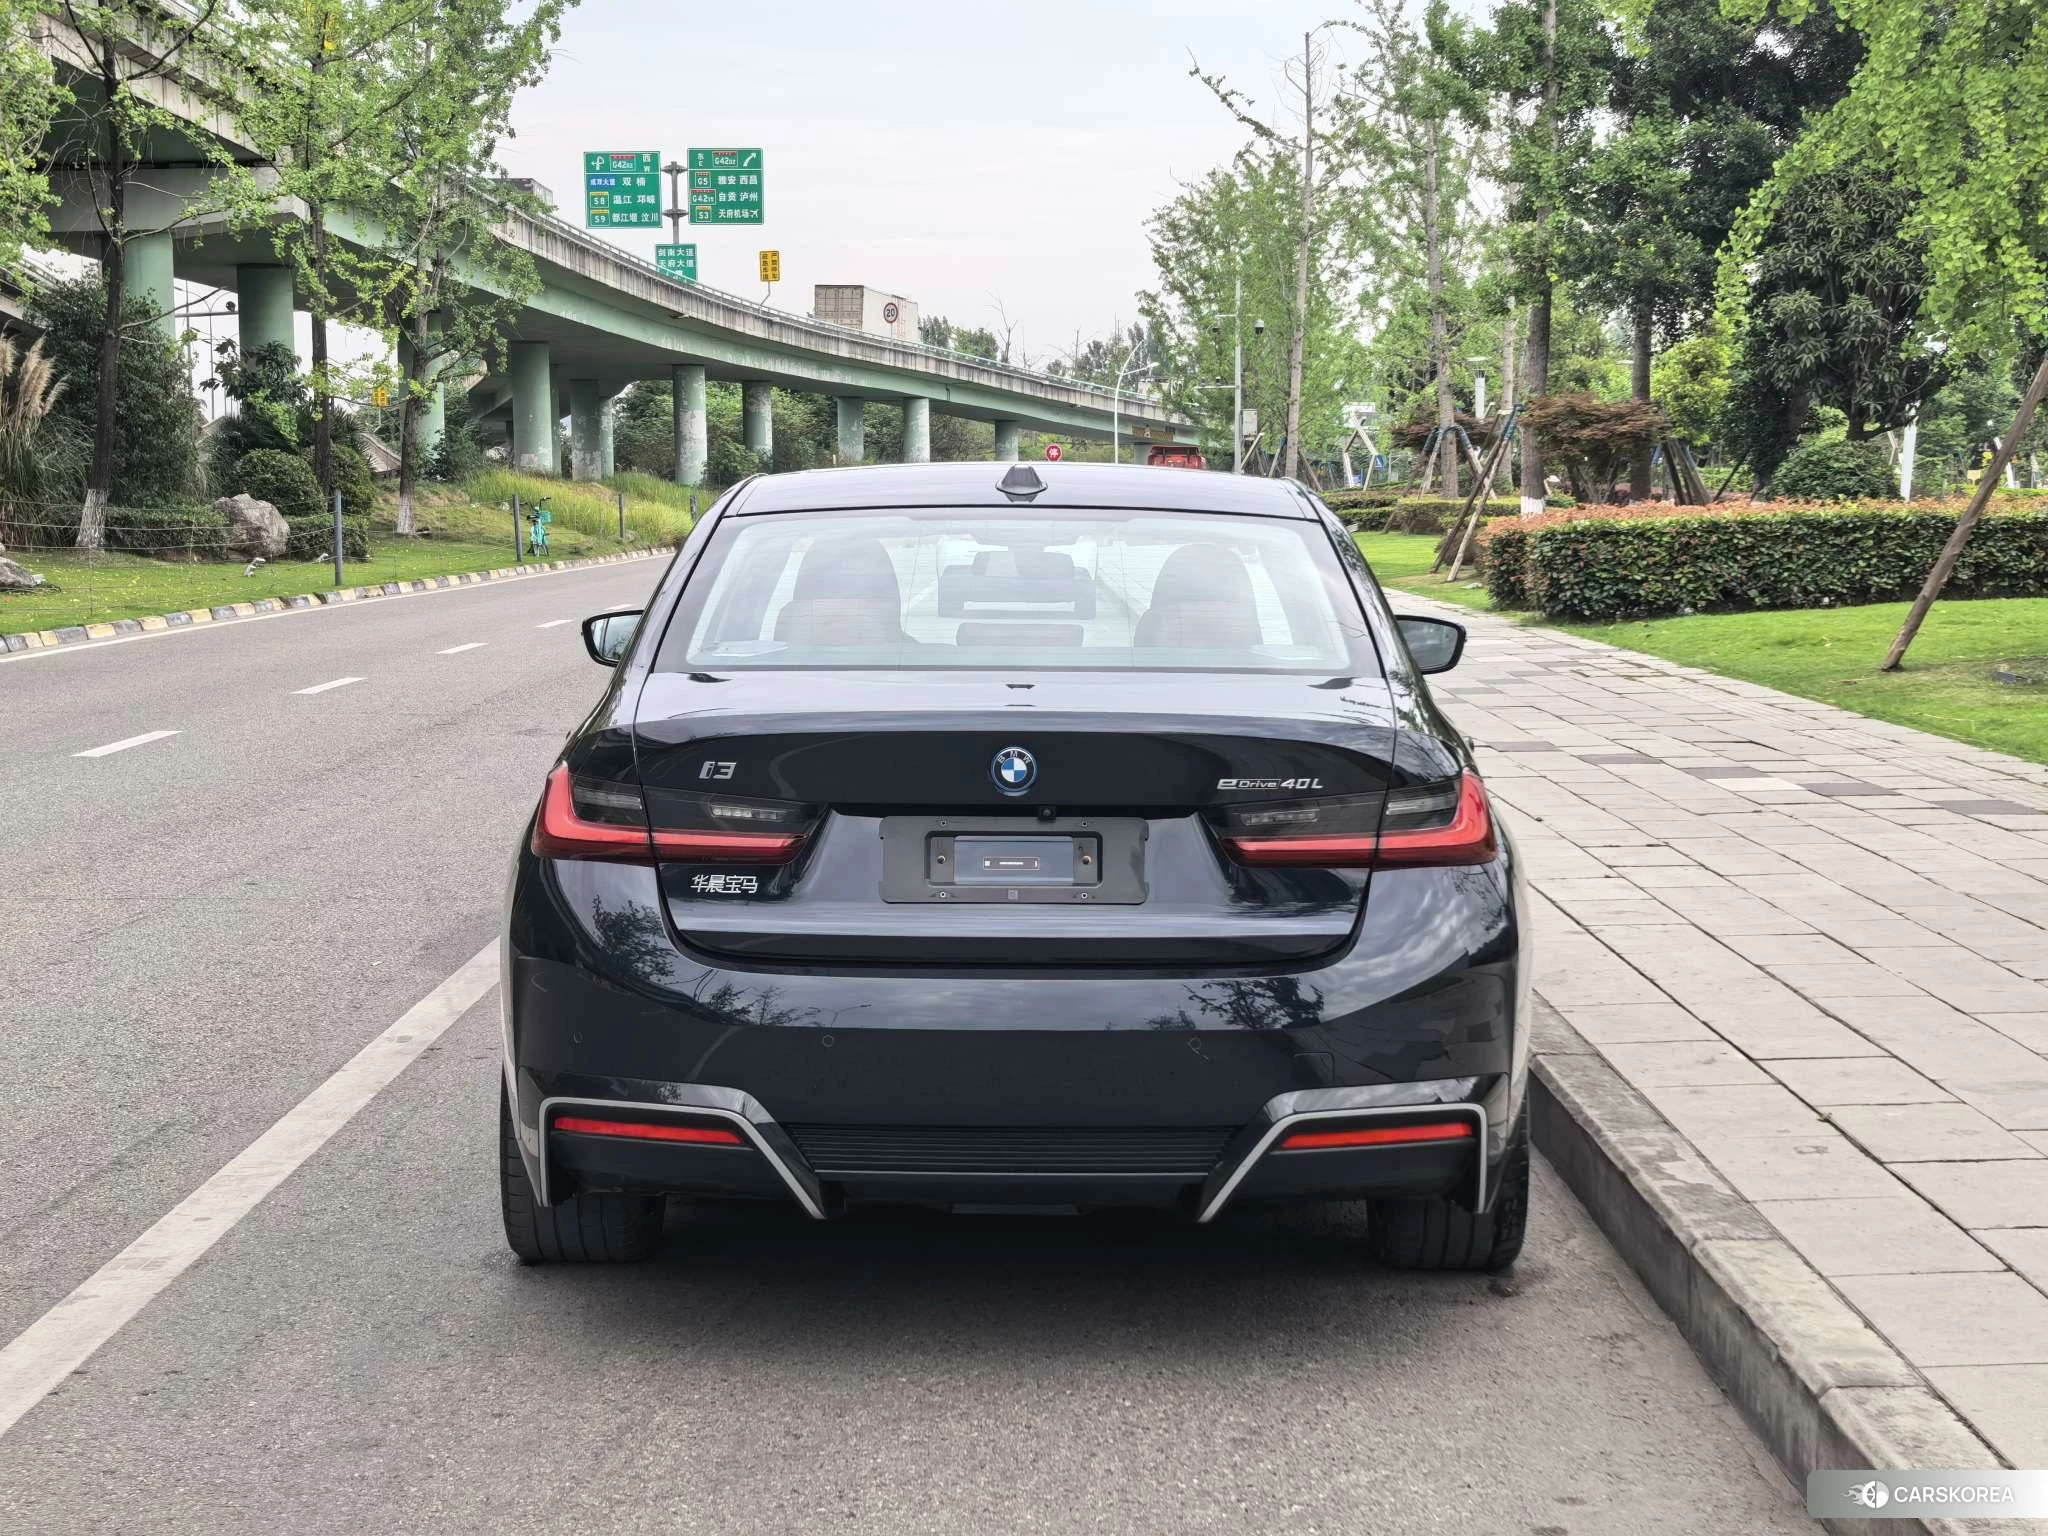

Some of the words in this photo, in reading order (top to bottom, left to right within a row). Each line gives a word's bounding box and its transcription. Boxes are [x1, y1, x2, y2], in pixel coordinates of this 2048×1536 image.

[697, 177, 708, 186] G5
[718, 175, 736, 185] 雅安
[739, 175, 758, 185] 西昌
[593, 197, 605, 205] S8
[613, 195, 632, 204] 温江
[718, 191, 737, 202] 自贡
[740, 192, 758, 202] 泸州
[594, 215, 606, 223] S9
[612, 213, 638, 222] 都江堰
[641, 212, 659, 222] 汶川
[698, 211, 709, 219] S3
[718, 209, 750, 219] 天府机场
[886, 308, 895, 318] 20
[997, 750, 1031, 764] BMW
[699, 761, 737, 779] i3
[1217, 778, 1279, 790] eDrive
[1280, 778, 1324, 789] 40L
[690, 874, 758, 893] 华晨宝马
